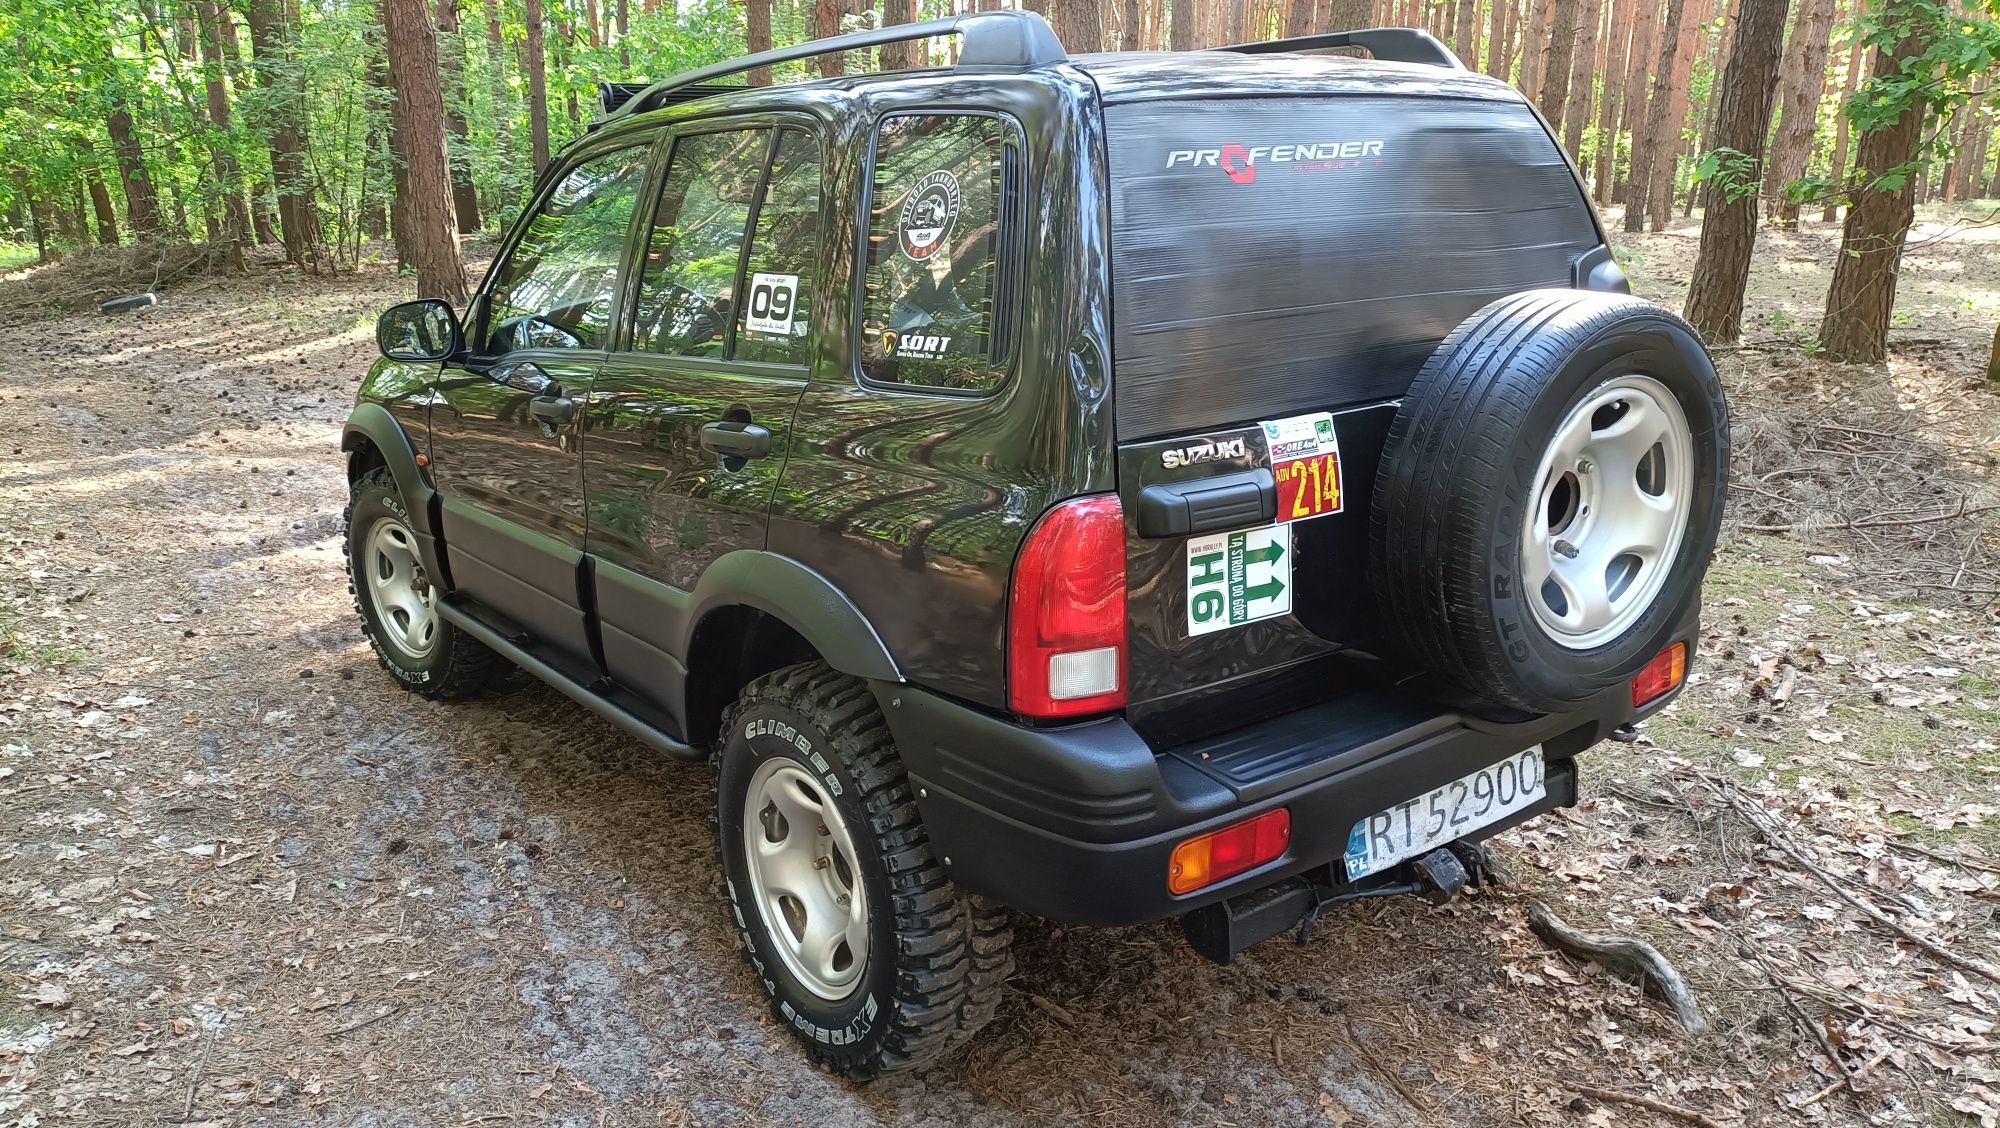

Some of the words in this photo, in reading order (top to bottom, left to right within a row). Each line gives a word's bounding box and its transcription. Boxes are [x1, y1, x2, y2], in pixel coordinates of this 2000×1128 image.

[1165, 140, 1384, 185] PROFENDER
[901, 180, 928, 223] OFFROAD
[931, 172, 958, 217] TARNOBRZEG
[907, 241, 937, 258] TEAM
[751, 284, 792, 321] 09
[898, 334, 952, 352] SORT
[1162, 437, 1246, 469] SUZUKI
[1275, 467, 1290, 483] ADV
[1291, 455, 1340, 518] 214
[1229, 535, 1244, 549] TĄ
[1229, 549, 1244, 585] STRONĄ
[1190, 551, 1225, 624] H6
[1232, 585, 1244, 597] DO
[1232, 598, 1247, 621] GÓRY
[1498, 617, 1530, 664] GT
[745, 719, 844, 797] CLIMBER
[1370, 797, 1421, 860] RT
[1426, 750, 1538, 839] 52900
[1348, 857, 1368, 874] PL
[780, 992, 878, 1045] EXTREME
